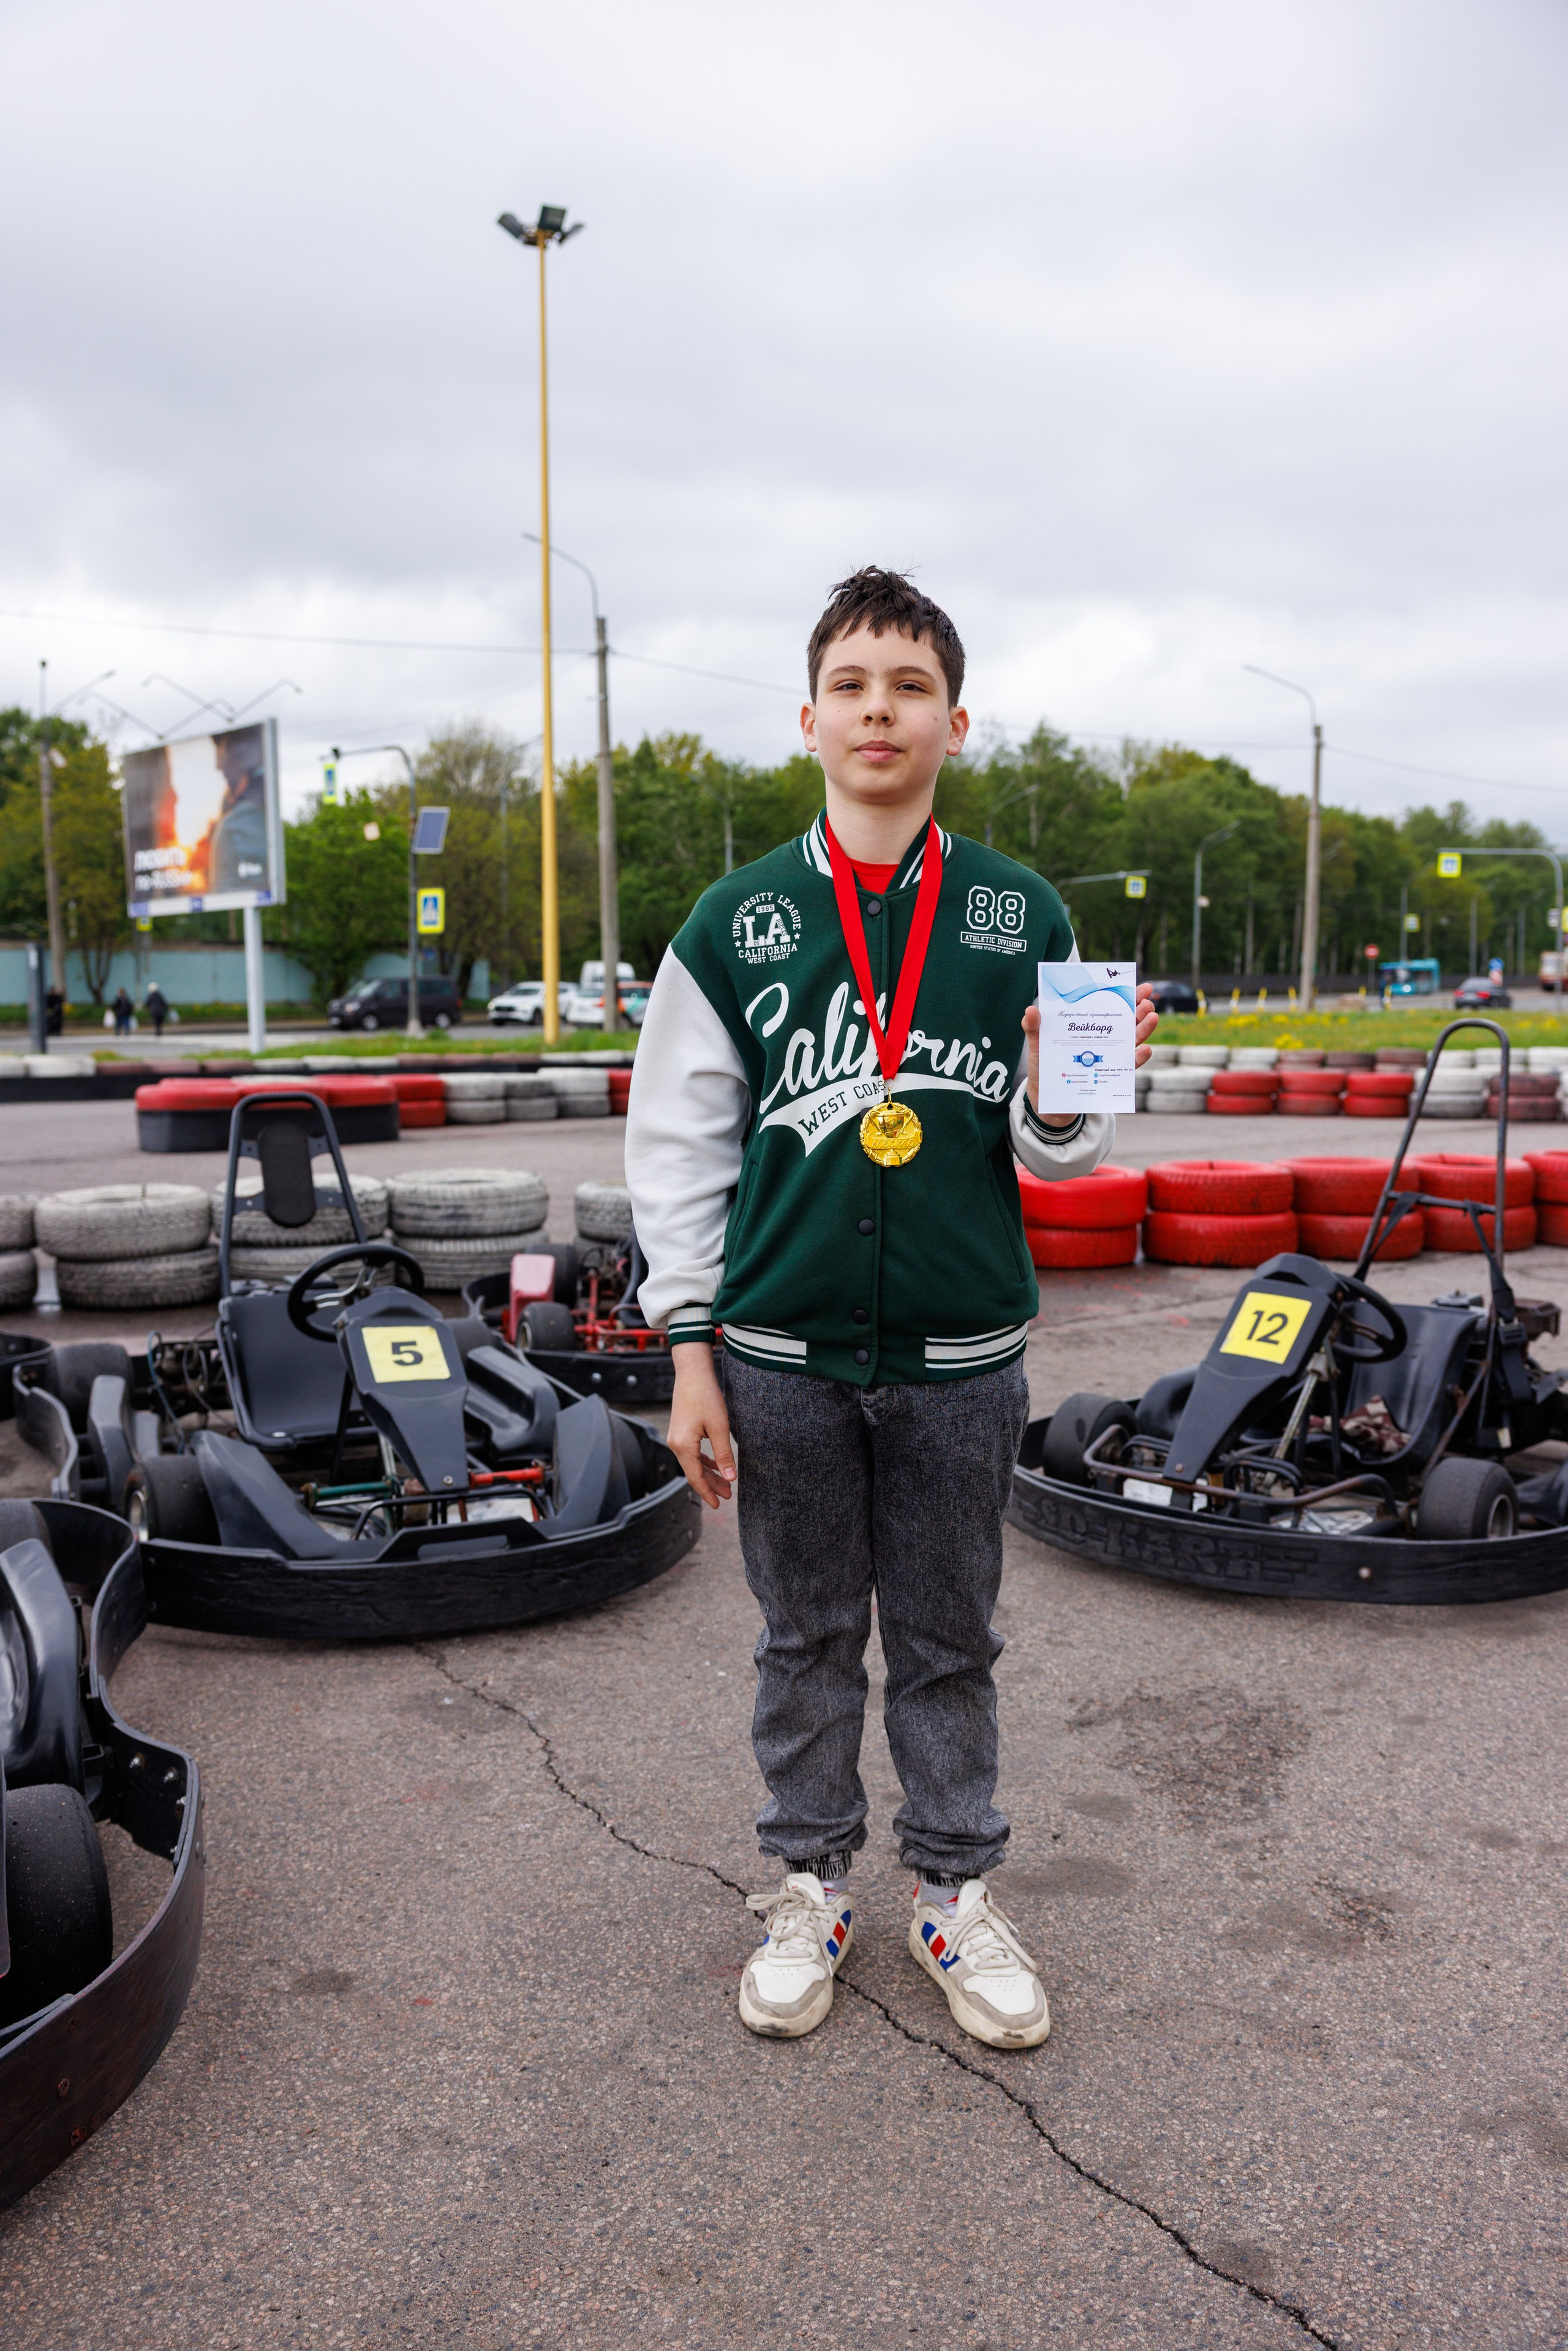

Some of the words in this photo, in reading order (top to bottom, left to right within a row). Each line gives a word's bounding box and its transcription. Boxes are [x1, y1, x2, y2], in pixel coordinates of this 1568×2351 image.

[733, 892, 774, 937] UNIVERSITY
[777, 894, 801, 930] LEAGUE
[967, 885, 1025, 934] 88
[738, 943, 797, 958] CALIFORNIA
[965, 934, 995, 944] ATHLETIC
[997, 938, 1022, 949] DIVISION
[769, 953, 790, 962] COAST
[1068, 1022, 1114, 1034] Вейкборд
[797, 1091, 848, 1137] WEST
[853, 1080, 886, 1100] COAS
[1246, 1310, 1288, 1345] 12
[391, 1341, 423, 1366] 5
